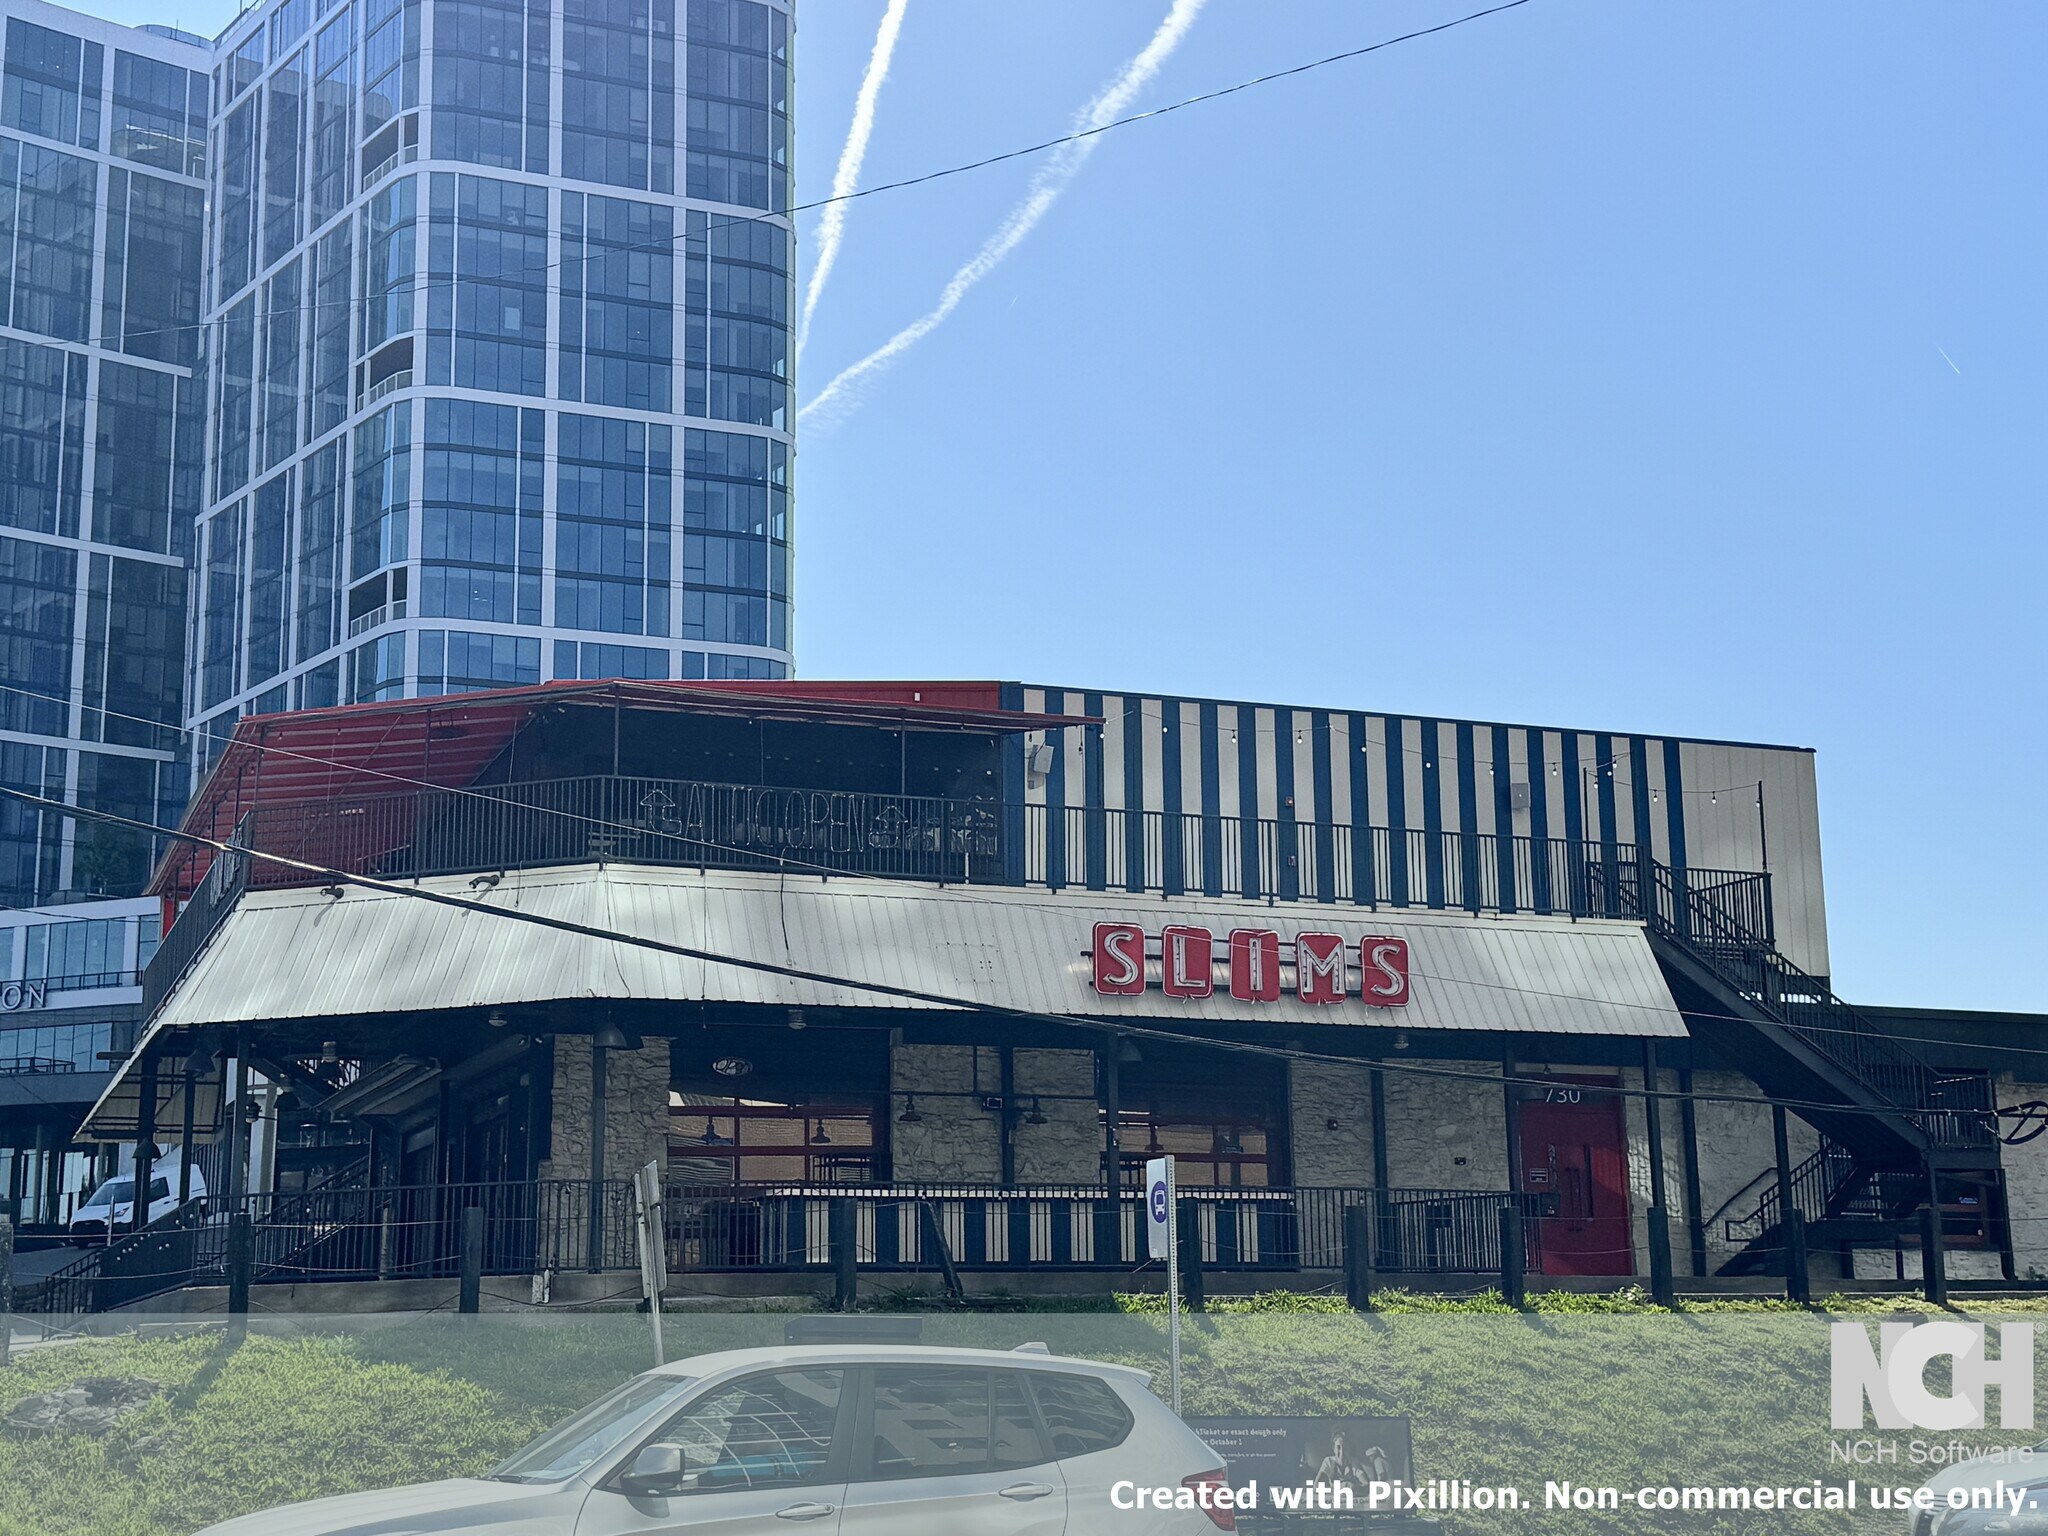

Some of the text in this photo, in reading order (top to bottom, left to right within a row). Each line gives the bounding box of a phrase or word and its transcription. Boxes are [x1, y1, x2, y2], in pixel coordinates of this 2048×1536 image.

[784, 790, 866, 853] OPEN
[1102, 929, 1405, 997] SLIMS
[1209, 1438, 1237, 1446] October
[1230, 1428, 1249, 1436] exact
[1250, 1428, 1271, 1437] dough
[1272, 1428, 1287, 1437] only
